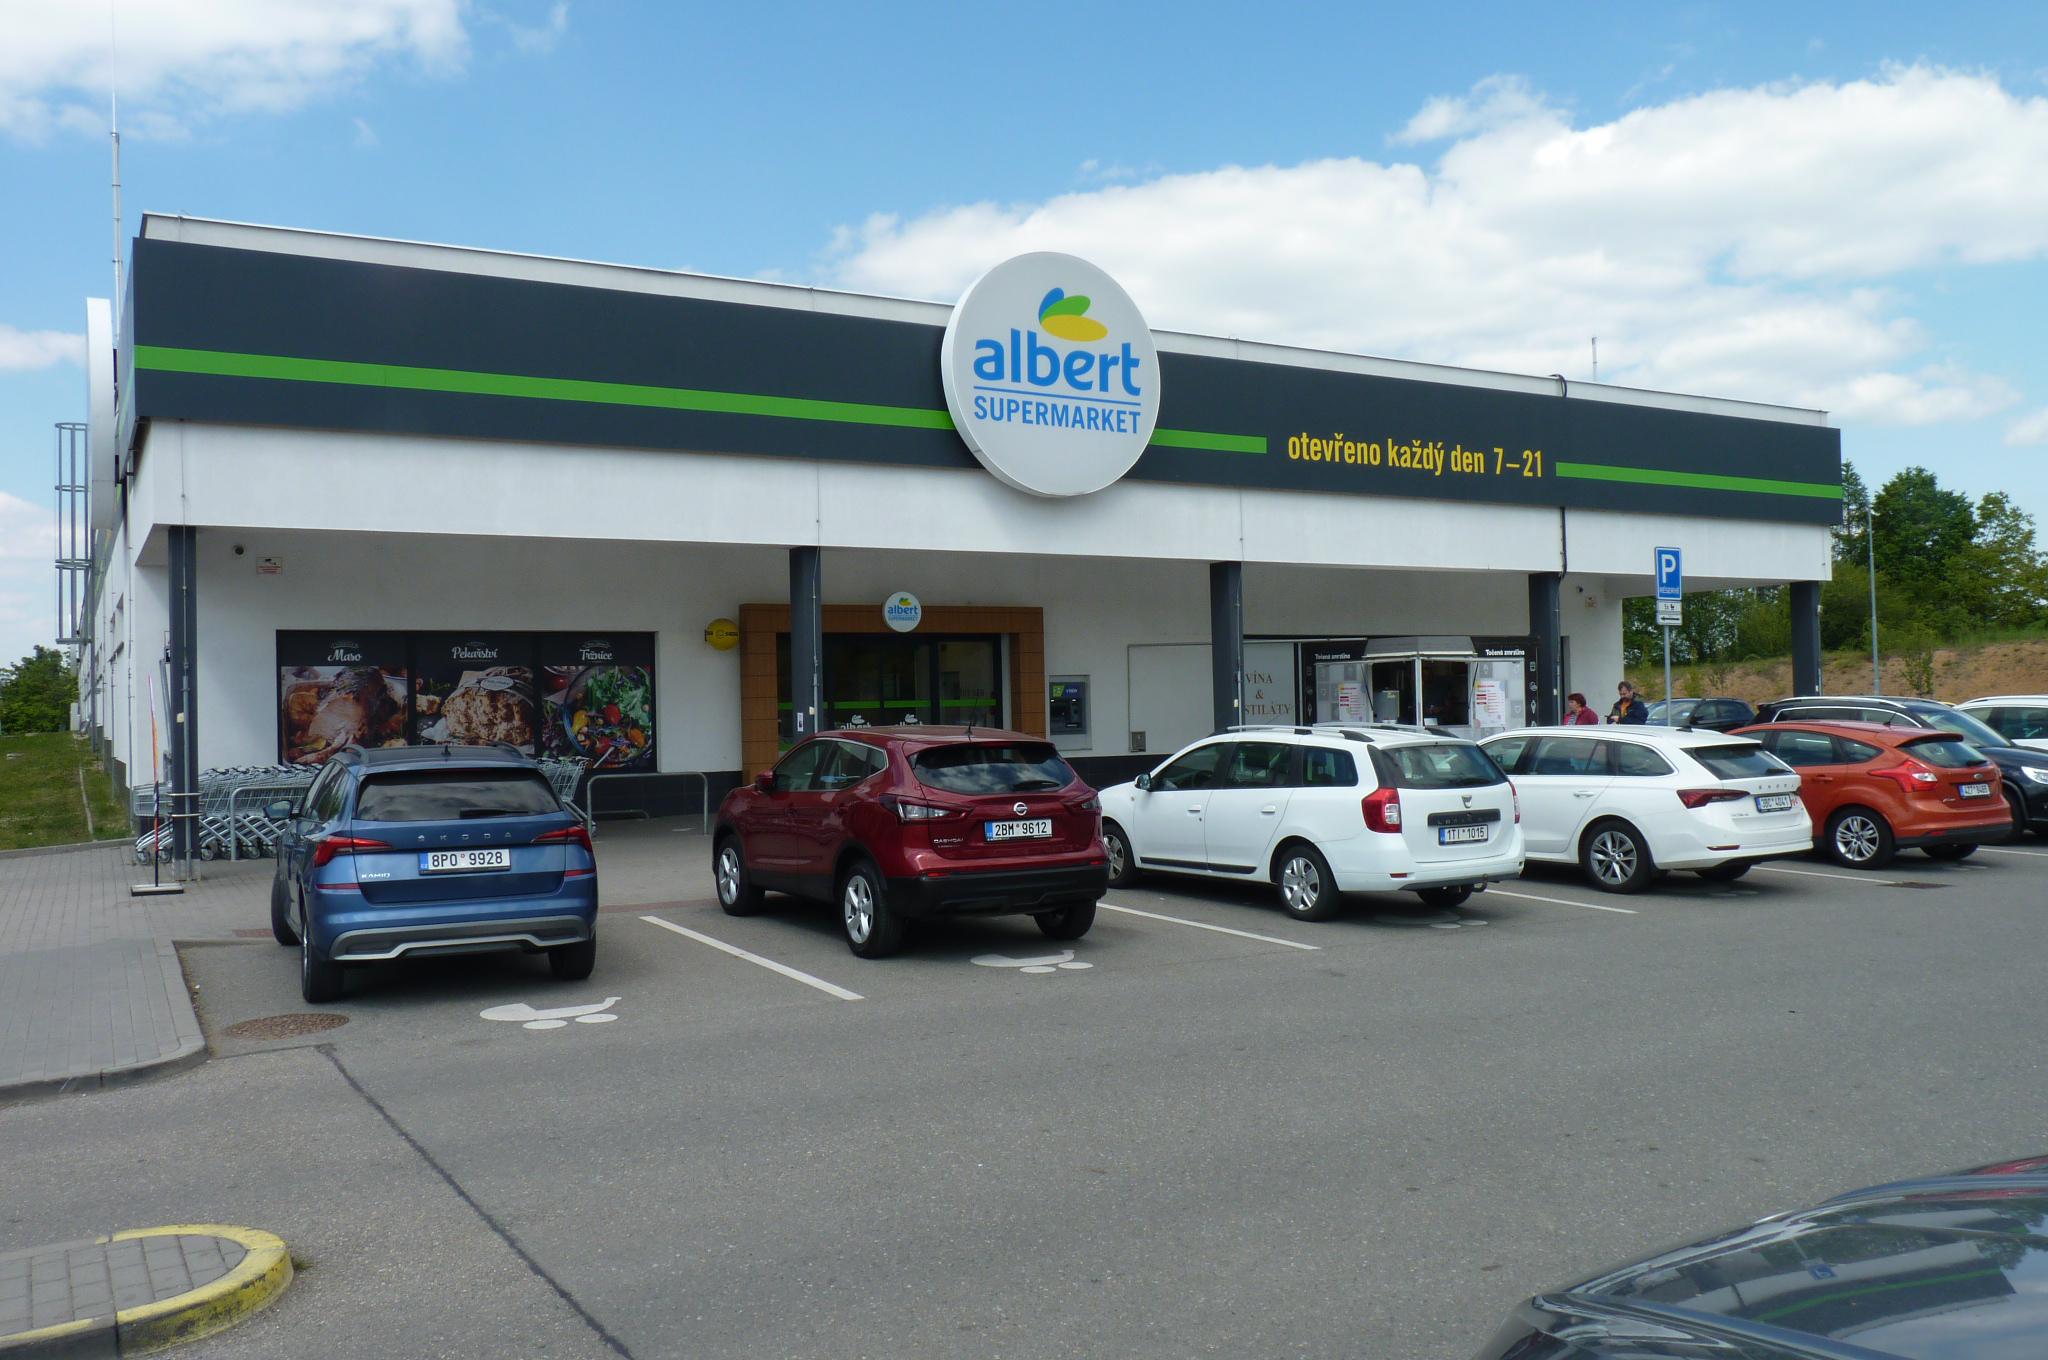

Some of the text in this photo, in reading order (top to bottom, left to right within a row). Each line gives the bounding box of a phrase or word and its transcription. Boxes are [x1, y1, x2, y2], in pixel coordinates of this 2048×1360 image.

[973, 328, 1141, 396] albert
[974, 395, 1141, 434] SUPERMARKET
[1287, 432, 1381, 466] otevřeno
[1387, 439, 1445, 476] každý
[1450, 445, 1485, 474] den
[1661, 554, 1677, 584] P
[887, 605, 919, 615] albert
[327, 648, 362, 661] Maso
[451, 646, 499, 659] Pekařství
[1255, 689, 1264, 700] &
[1244, 701, 1291, 716] STILÁTY
[995, 821, 1048, 837] 2BM 9612
[1467, 827, 1485, 839] 1015
[468, 851, 503, 866] 9928
